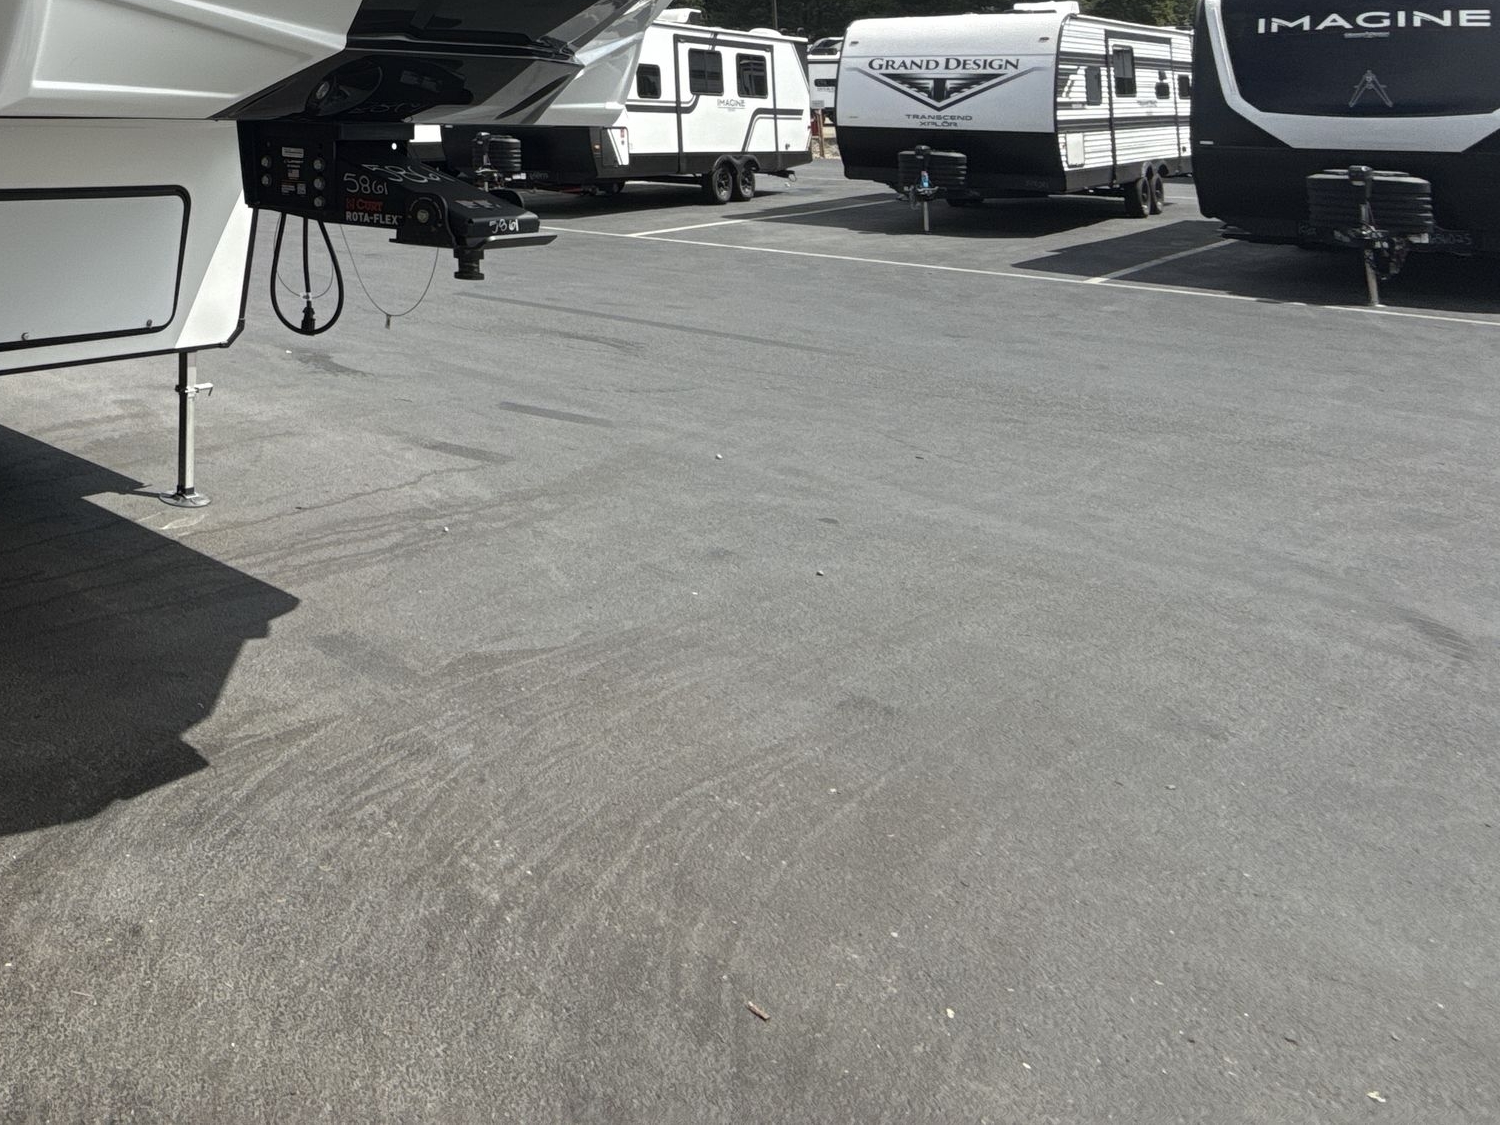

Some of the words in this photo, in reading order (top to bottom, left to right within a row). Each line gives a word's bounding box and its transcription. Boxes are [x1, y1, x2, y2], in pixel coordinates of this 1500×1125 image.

[1257, 9, 1492, 34] IMAGINE
[868, 57, 940, 71] GRAND
[943, 57, 1020, 71] DESIGN
[717, 98, 746, 108] IMAGINE
[343, 172, 388, 195] 5861
[345, 211, 398, 225] ROTA-FLEX
[489, 218, 519, 234] 5861
